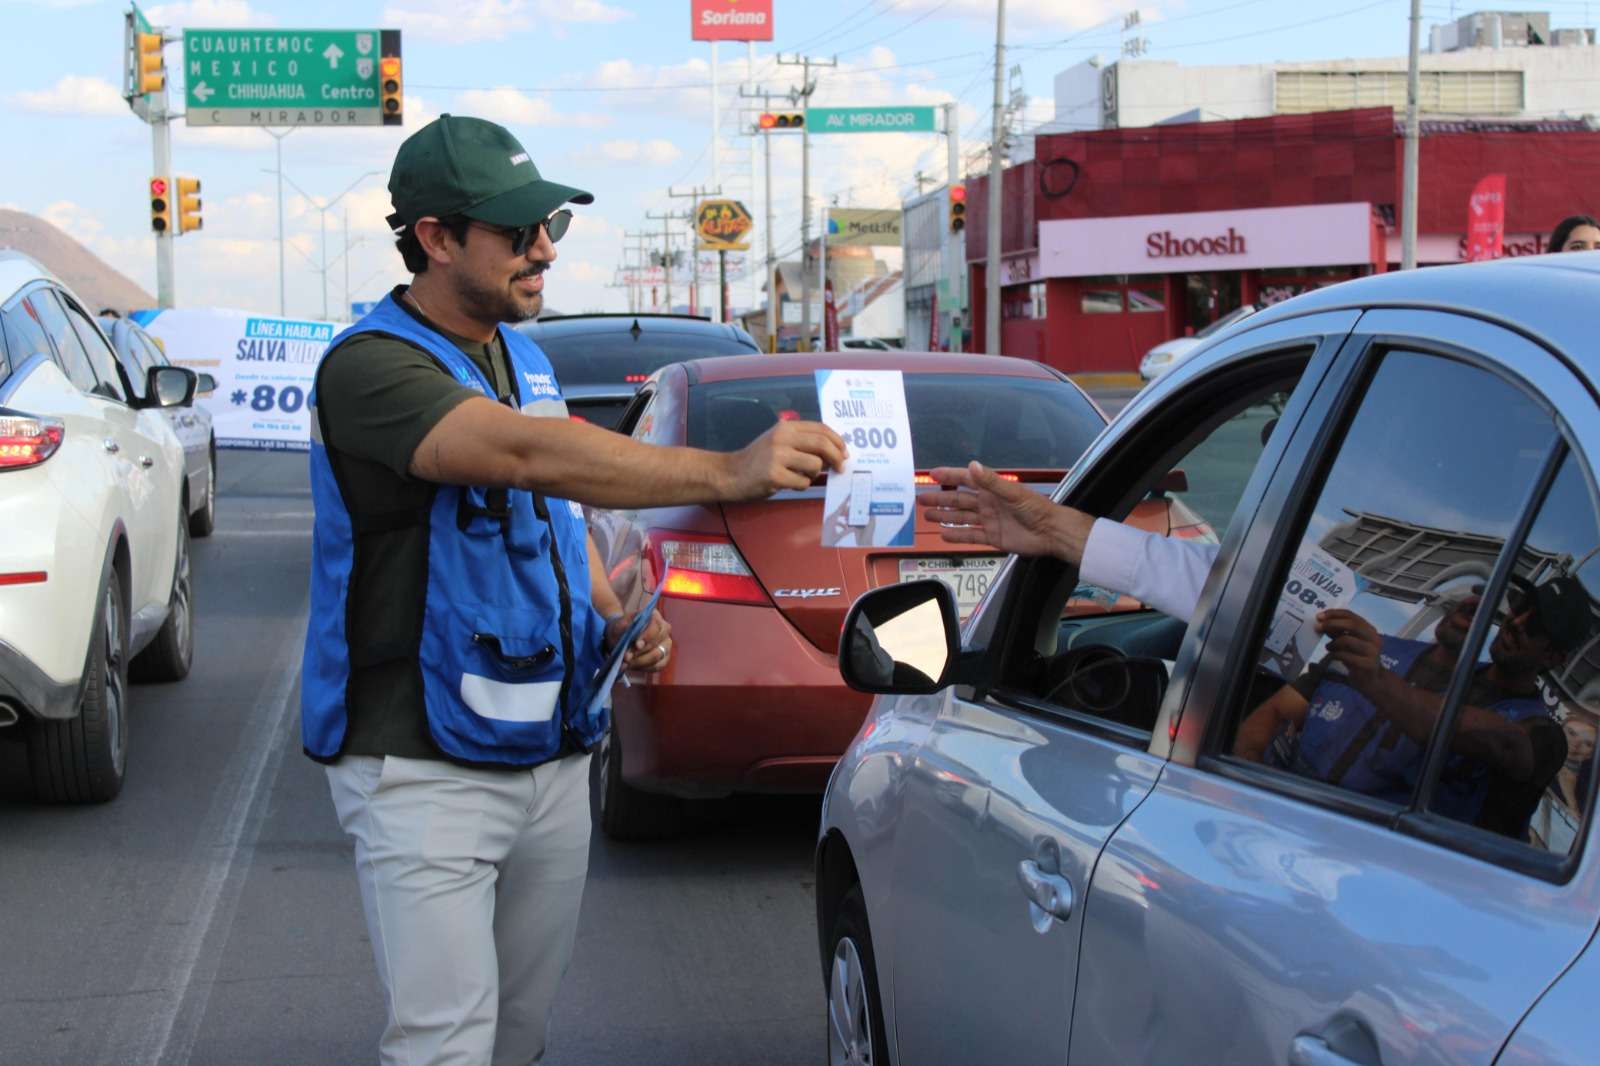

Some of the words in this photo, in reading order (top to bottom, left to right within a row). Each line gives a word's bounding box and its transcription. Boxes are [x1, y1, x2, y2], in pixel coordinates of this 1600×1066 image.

[190, 36, 314, 53] CUAUHTEMOC
[191, 60, 298, 76] MEXICO
[228, 84, 305, 99] CHIHUAHUA
[321, 84, 375, 99] Centro
[211, 110, 221, 123] C
[250, 111, 357, 123] MIRADOR
[850, 112, 915, 127] MIRADOR
[848, 221, 899, 235] MetLife
[1146, 227, 1246, 258] Shoosh
[250, 319, 283, 337] LÍNEA
[285, 323, 329, 340] HABLAR
[927, 559, 988, 569] CHIHAHUA
[774, 588, 841, 598] CIVIC
